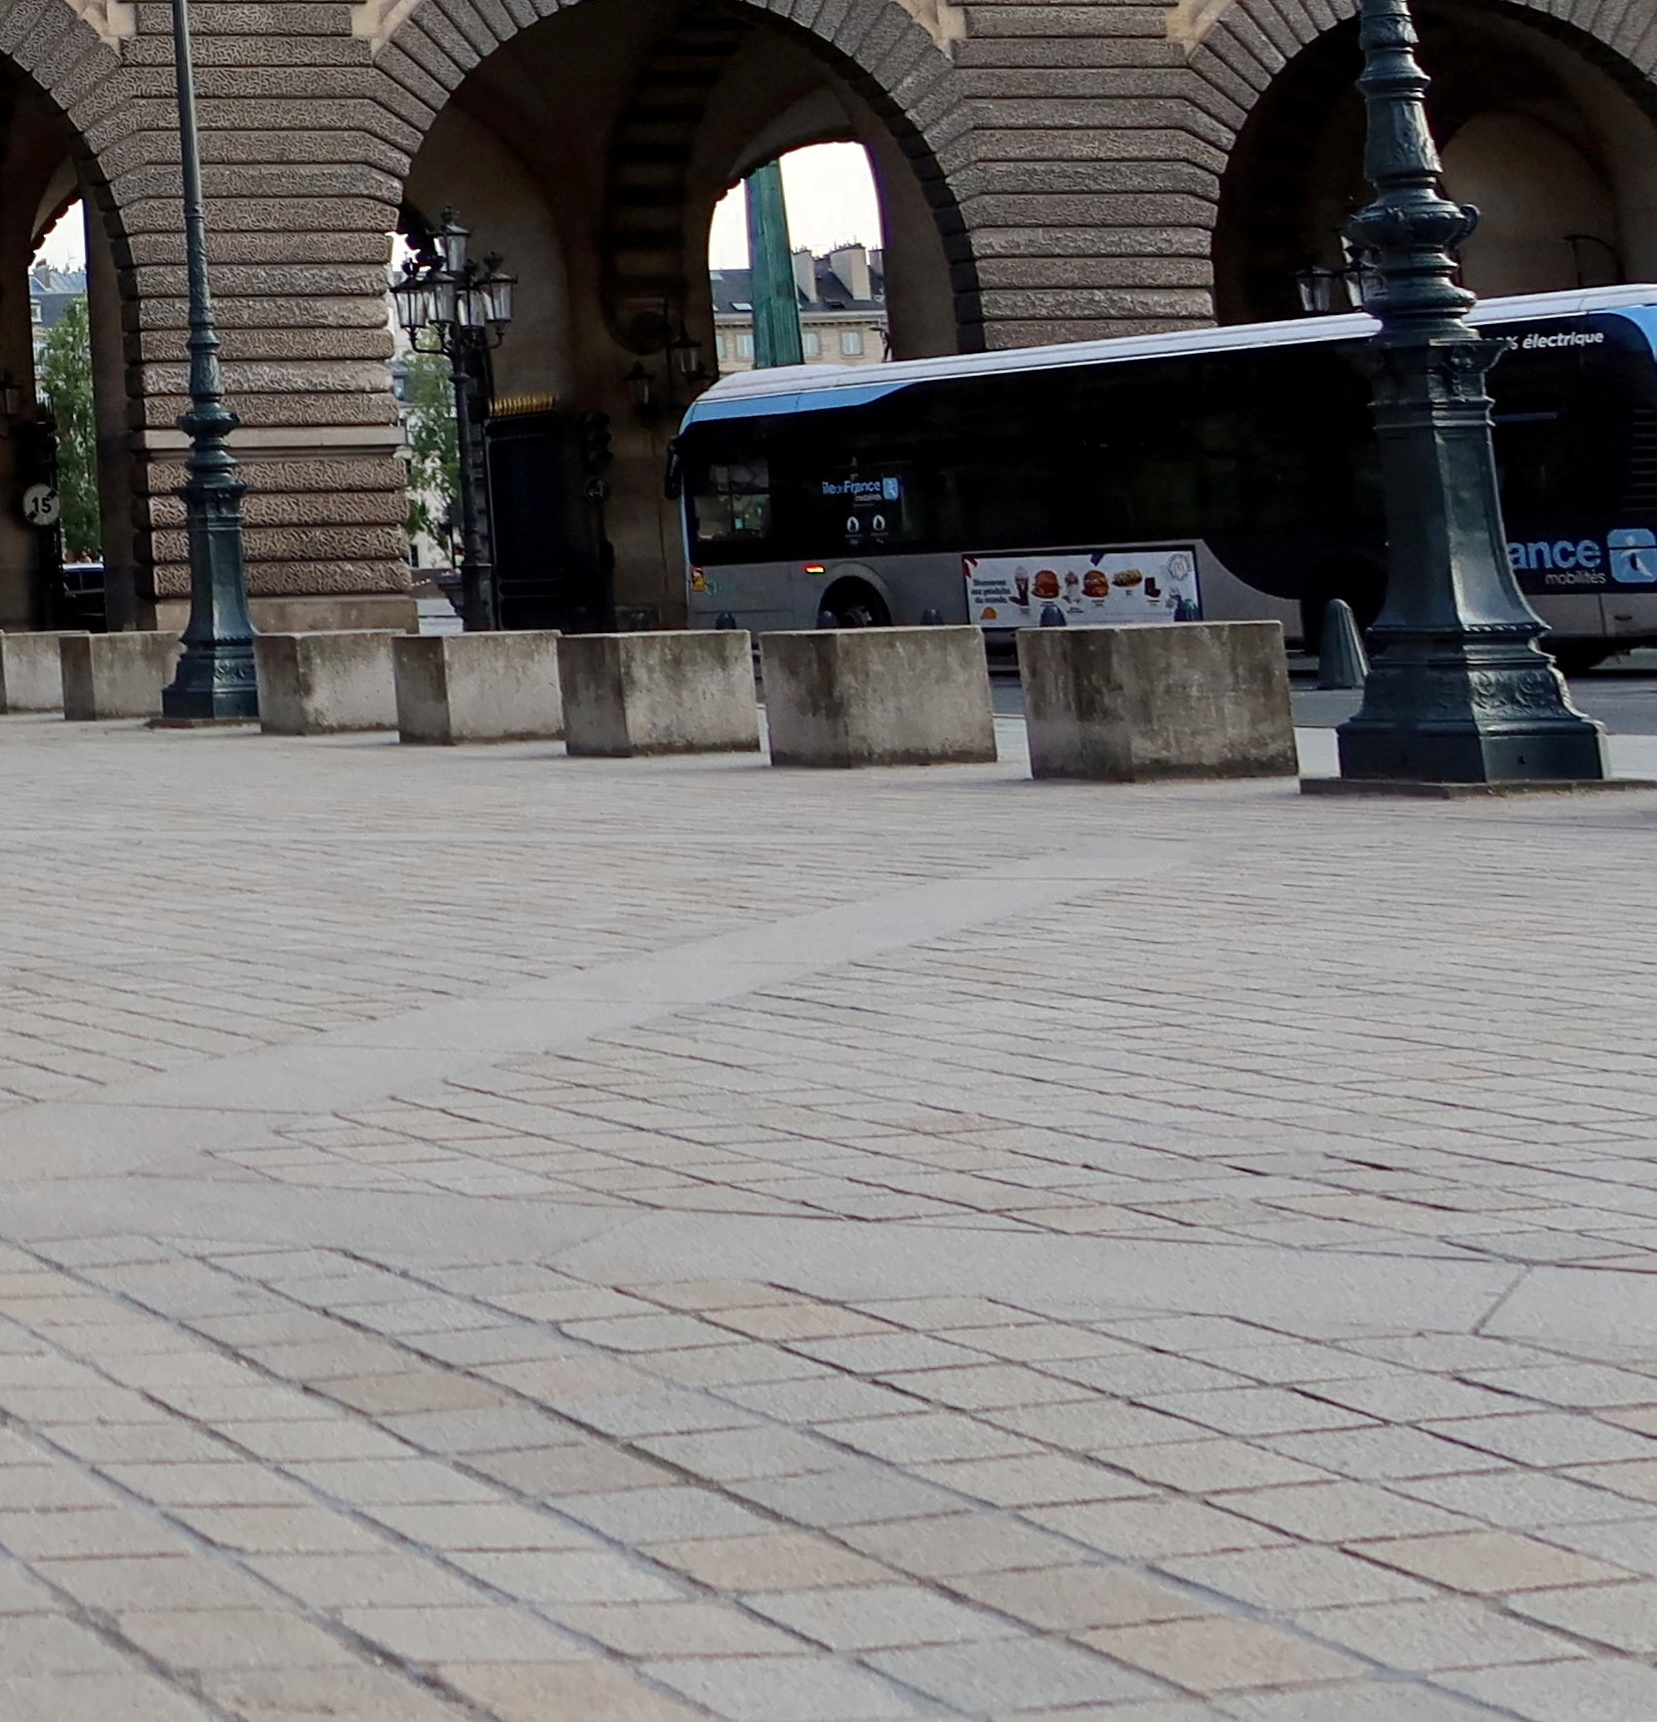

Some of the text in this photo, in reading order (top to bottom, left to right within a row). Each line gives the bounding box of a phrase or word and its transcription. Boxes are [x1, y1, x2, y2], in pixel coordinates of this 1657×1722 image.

[1522, 331, 1604, 349] électrique
[32, 497, 52, 514] 15
[1506, 540, 1602, 570] ance
[1545, 569, 1607, 585] mobilités
